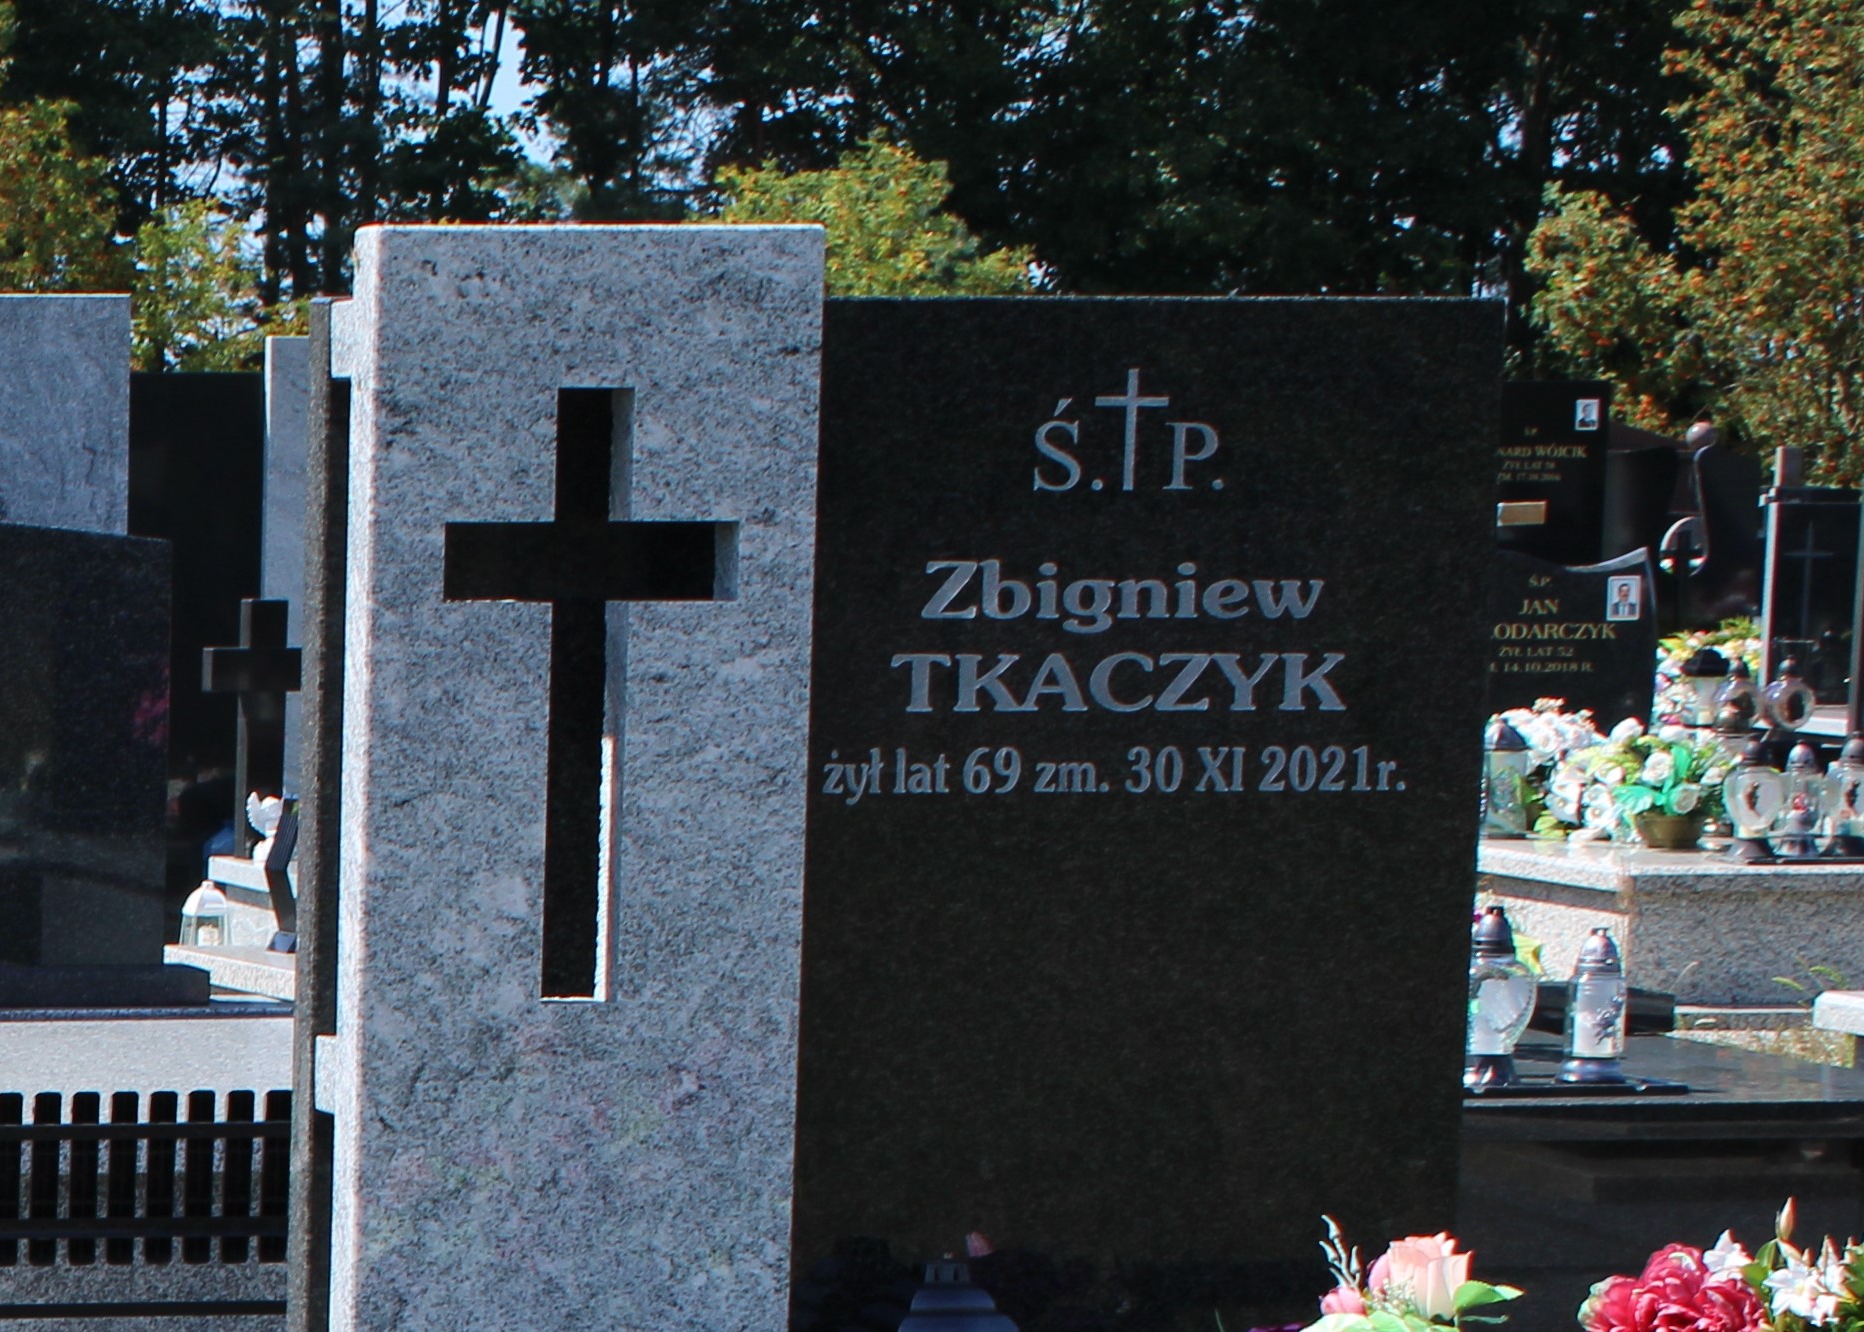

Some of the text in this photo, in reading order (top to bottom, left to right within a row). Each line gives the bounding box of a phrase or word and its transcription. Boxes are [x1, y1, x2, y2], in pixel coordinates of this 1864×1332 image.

[1033, 399, 1225, 492] Ś. P.
[921, 560, 1325, 634] Zbigniew
[1519, 598, 1560, 615] JAN
[1527, 646, 1553, 657] LAT
[1558, 646, 1574, 657] 52
[891, 652, 1347, 712] TKACZYK
[822, 745, 1407, 805] żył lat 69 zm. 30 XI 2021r.
